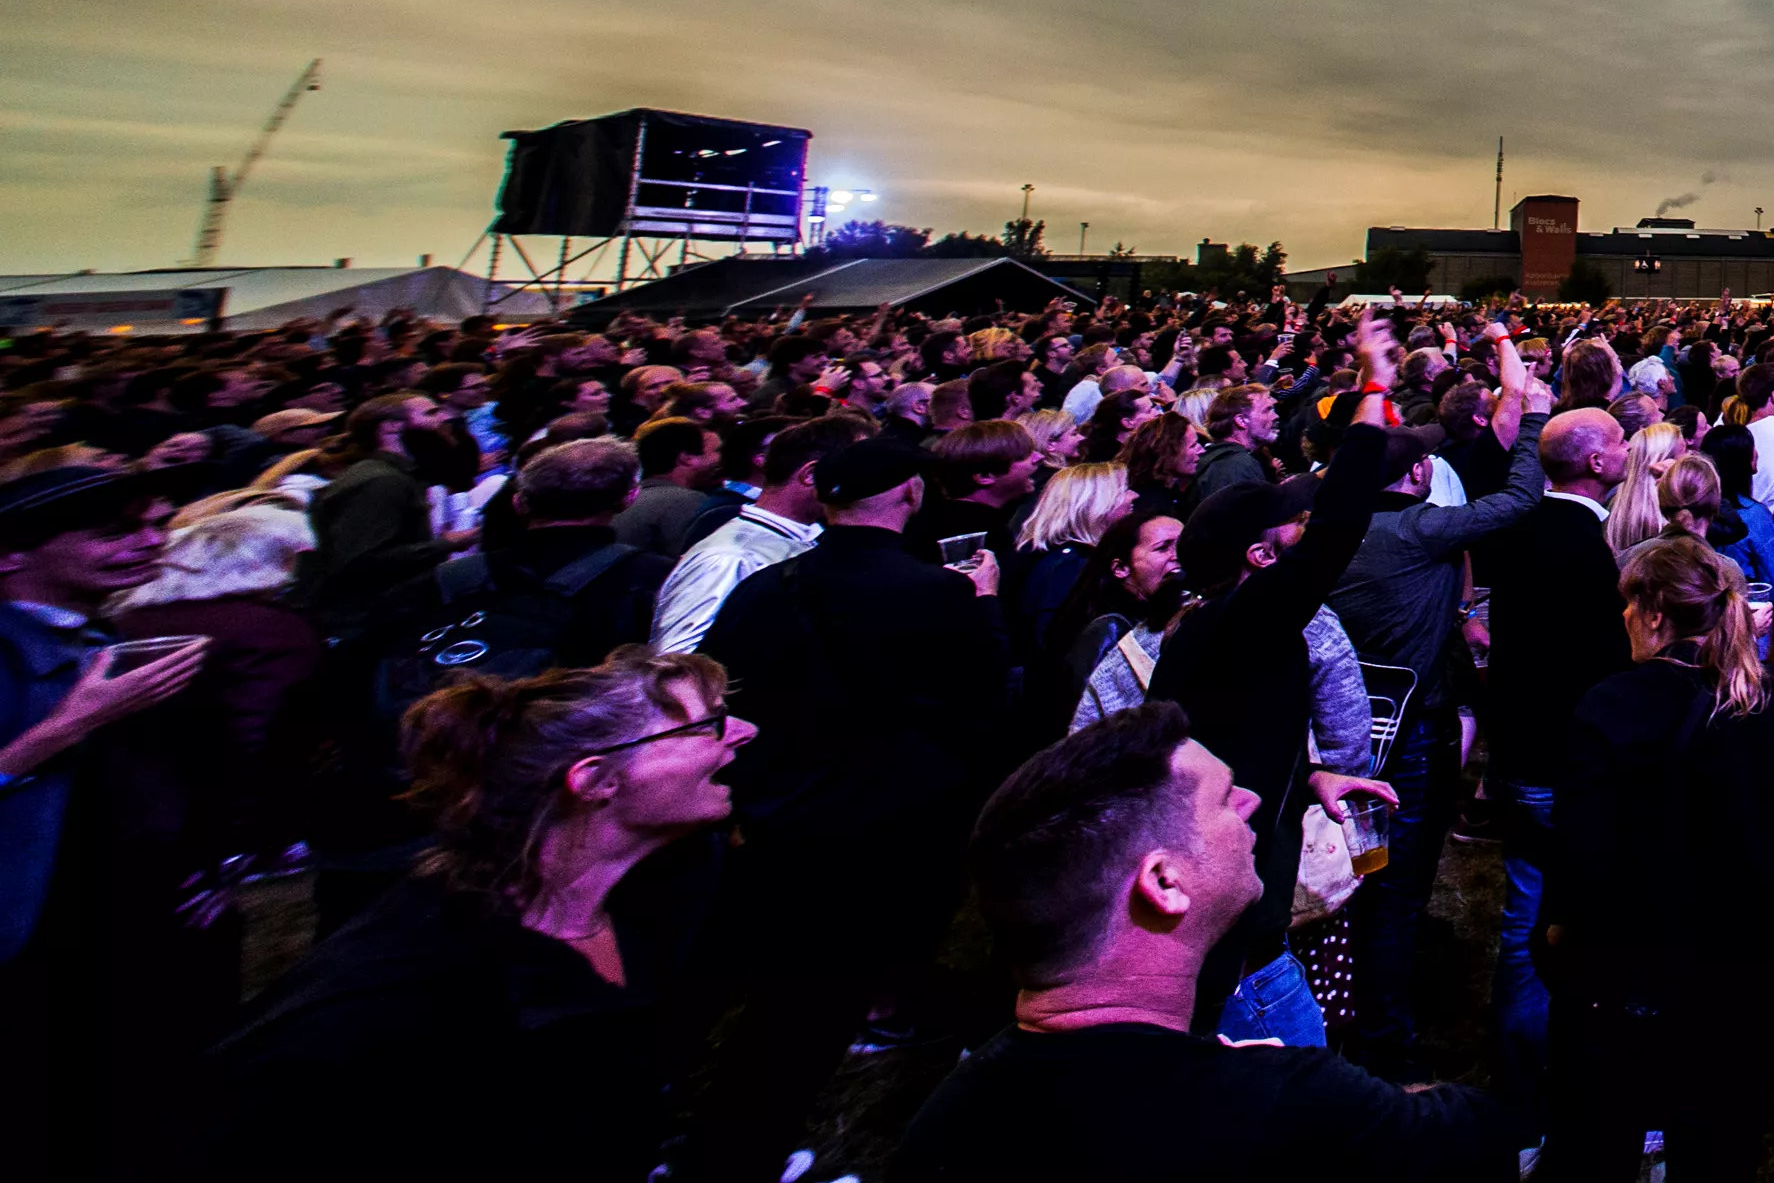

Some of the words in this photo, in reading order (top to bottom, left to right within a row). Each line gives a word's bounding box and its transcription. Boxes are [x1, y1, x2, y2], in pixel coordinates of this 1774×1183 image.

[1528, 217, 1556, 225] Blocs
[1536, 225, 1543, 233] &
[1545, 222, 1572, 233] Walls
